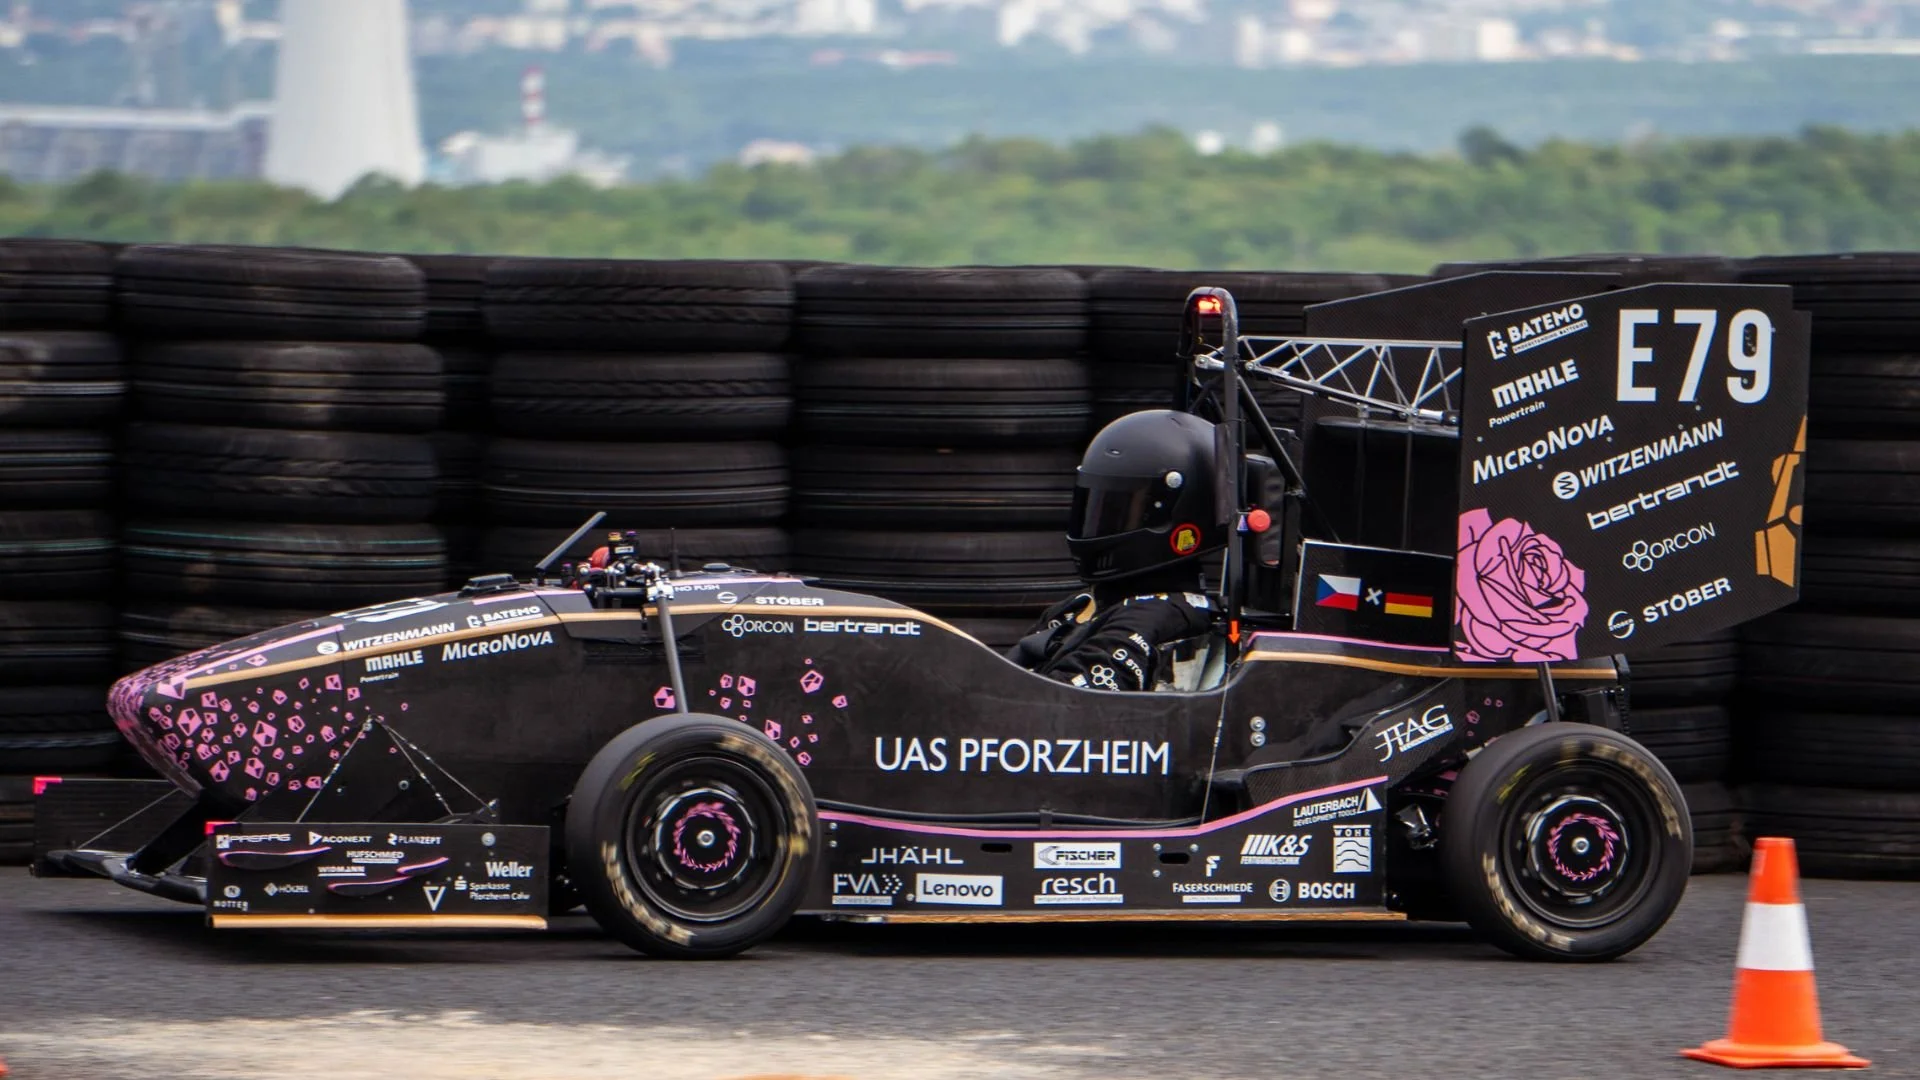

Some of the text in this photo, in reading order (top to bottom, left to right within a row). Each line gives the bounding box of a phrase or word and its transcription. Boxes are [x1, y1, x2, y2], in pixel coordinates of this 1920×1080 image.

[1507, 303, 1584, 343] BATEMO
[1492, 359, 1579, 409] MAHLE
[1489, 401, 1545, 428] Powertrain
[1580, 418, 1723, 487] WITZENMANN
[1586, 461, 1740, 530] bertrandt
[1649, 522, 1716, 559] ORCON
[482, 606, 541, 622] BATEMO
[743, 620, 794, 633] ORCON
[804, 618, 920, 636] bertrandt
[343, 622, 455, 651] WITZENMANN
[365, 650, 423, 672] MAHLE
[359, 673, 399, 683] Powertrain
[875, 737, 1169, 775] UAS PFORZHEIM
[1293, 796, 1359, 819] LAUTERBACH
[1293, 809, 1358, 827] DEVELOPMENT TOOLS
[322, 836, 372, 844] ACONEXT
[399, 836, 442, 845] PLANZEPT
[346, 851, 404, 859] HUFSCHMIED
[861, 845, 964, 864] JHÄHL
[1056, 851, 1116, 860] FISCHER
[485, 861, 533, 877] Weller
[469, 882, 511, 891] Sparkasse
[923, 880, 993, 897] Lenovo
[1042, 872, 1115, 894] resch
[1172, 882, 1253, 893] FASERSCHMIEDE
[1298, 883, 1355, 899] BOSCH
[469, 891, 531, 901] Pforzheim Calw
